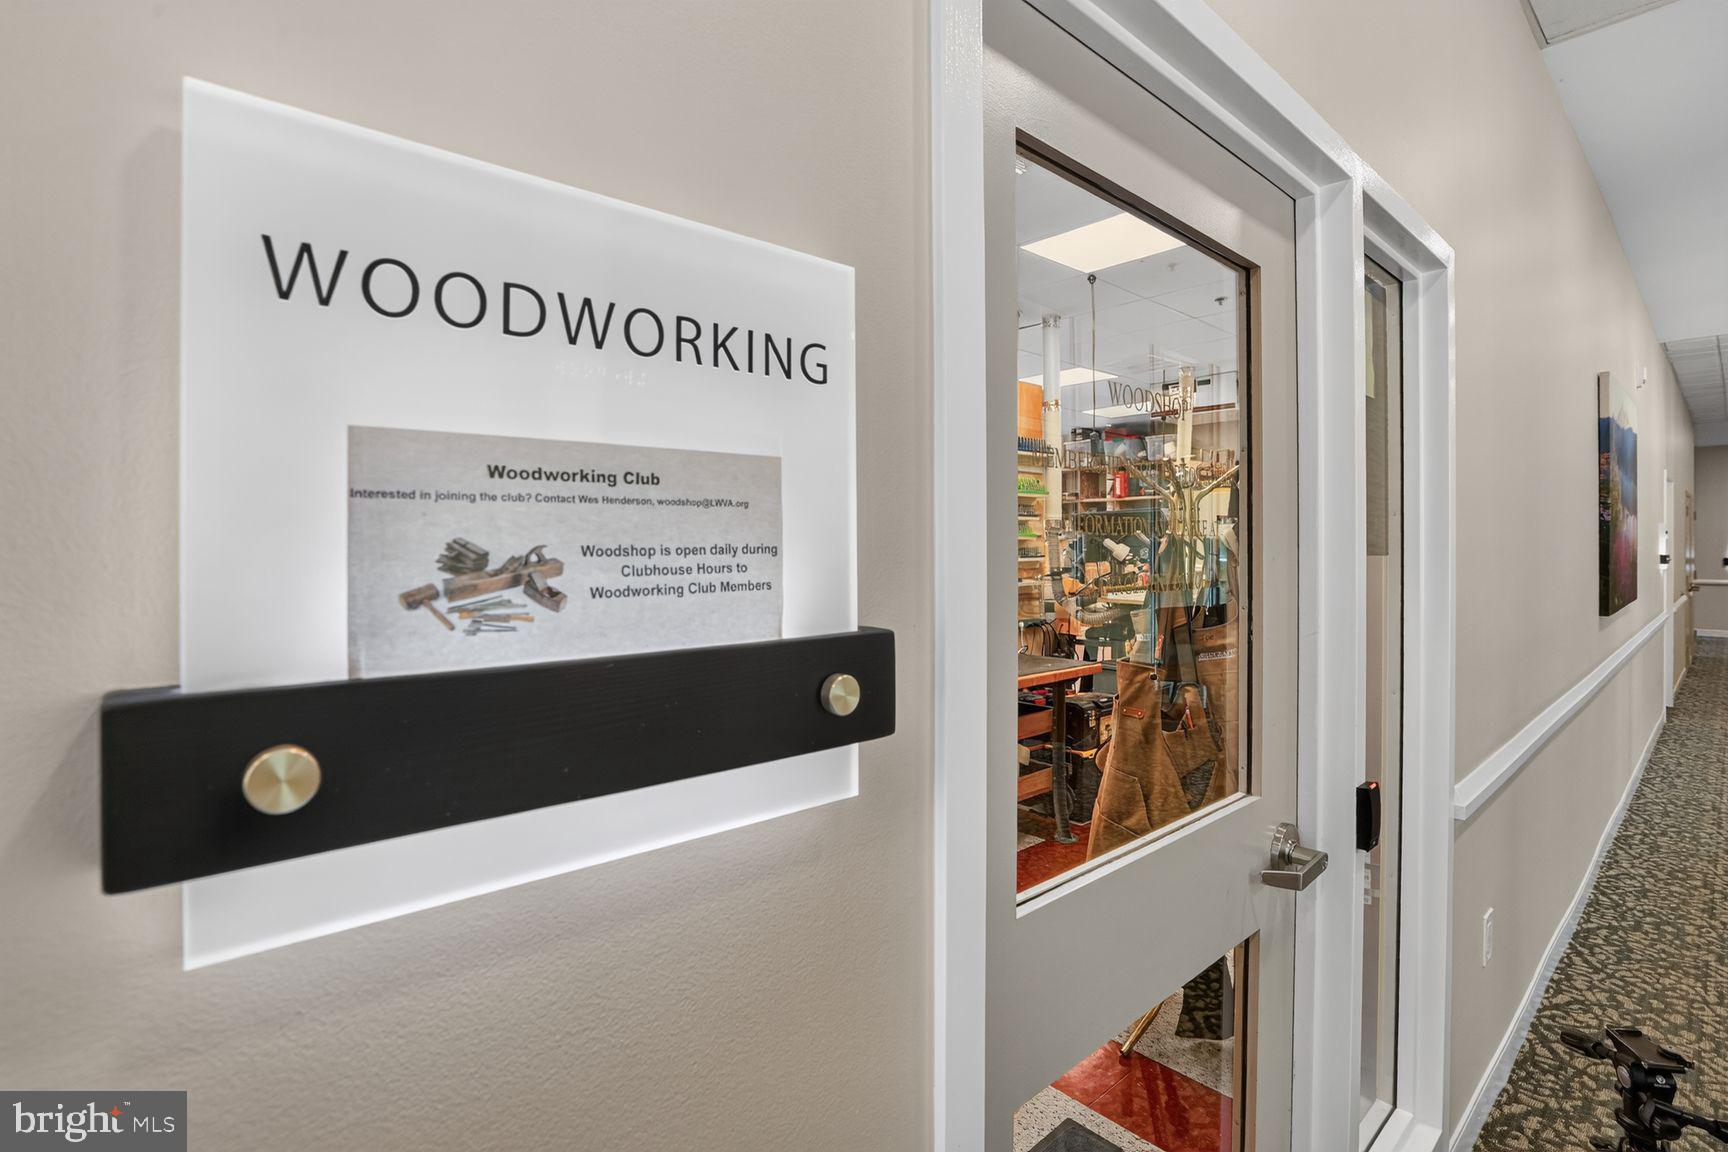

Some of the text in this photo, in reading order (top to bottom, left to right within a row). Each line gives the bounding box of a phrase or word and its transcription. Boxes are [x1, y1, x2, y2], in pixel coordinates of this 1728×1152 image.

[260, 233, 828, 385] WOODWORKING
[1107, 379, 1190, 421] WOODSHOP
[487, 464, 661, 488] Woodworking Club
[350, 487, 416, 500] Interested
[419, 491, 431, 500] in
[435, 492, 477, 503] joining
[479, 492, 498, 502] the
[500, 493, 532, 502] club?
[534, 493, 576, 504] Contact
[578, 494, 599, 504] Wes
[601, 495, 655, 506] Henderson,
[580, 543, 778, 560] Woodshop is open daily during
[621, 562, 748, 577] Clubhouse Hours to
[589, 580, 772, 600] Woodworking Club Members
